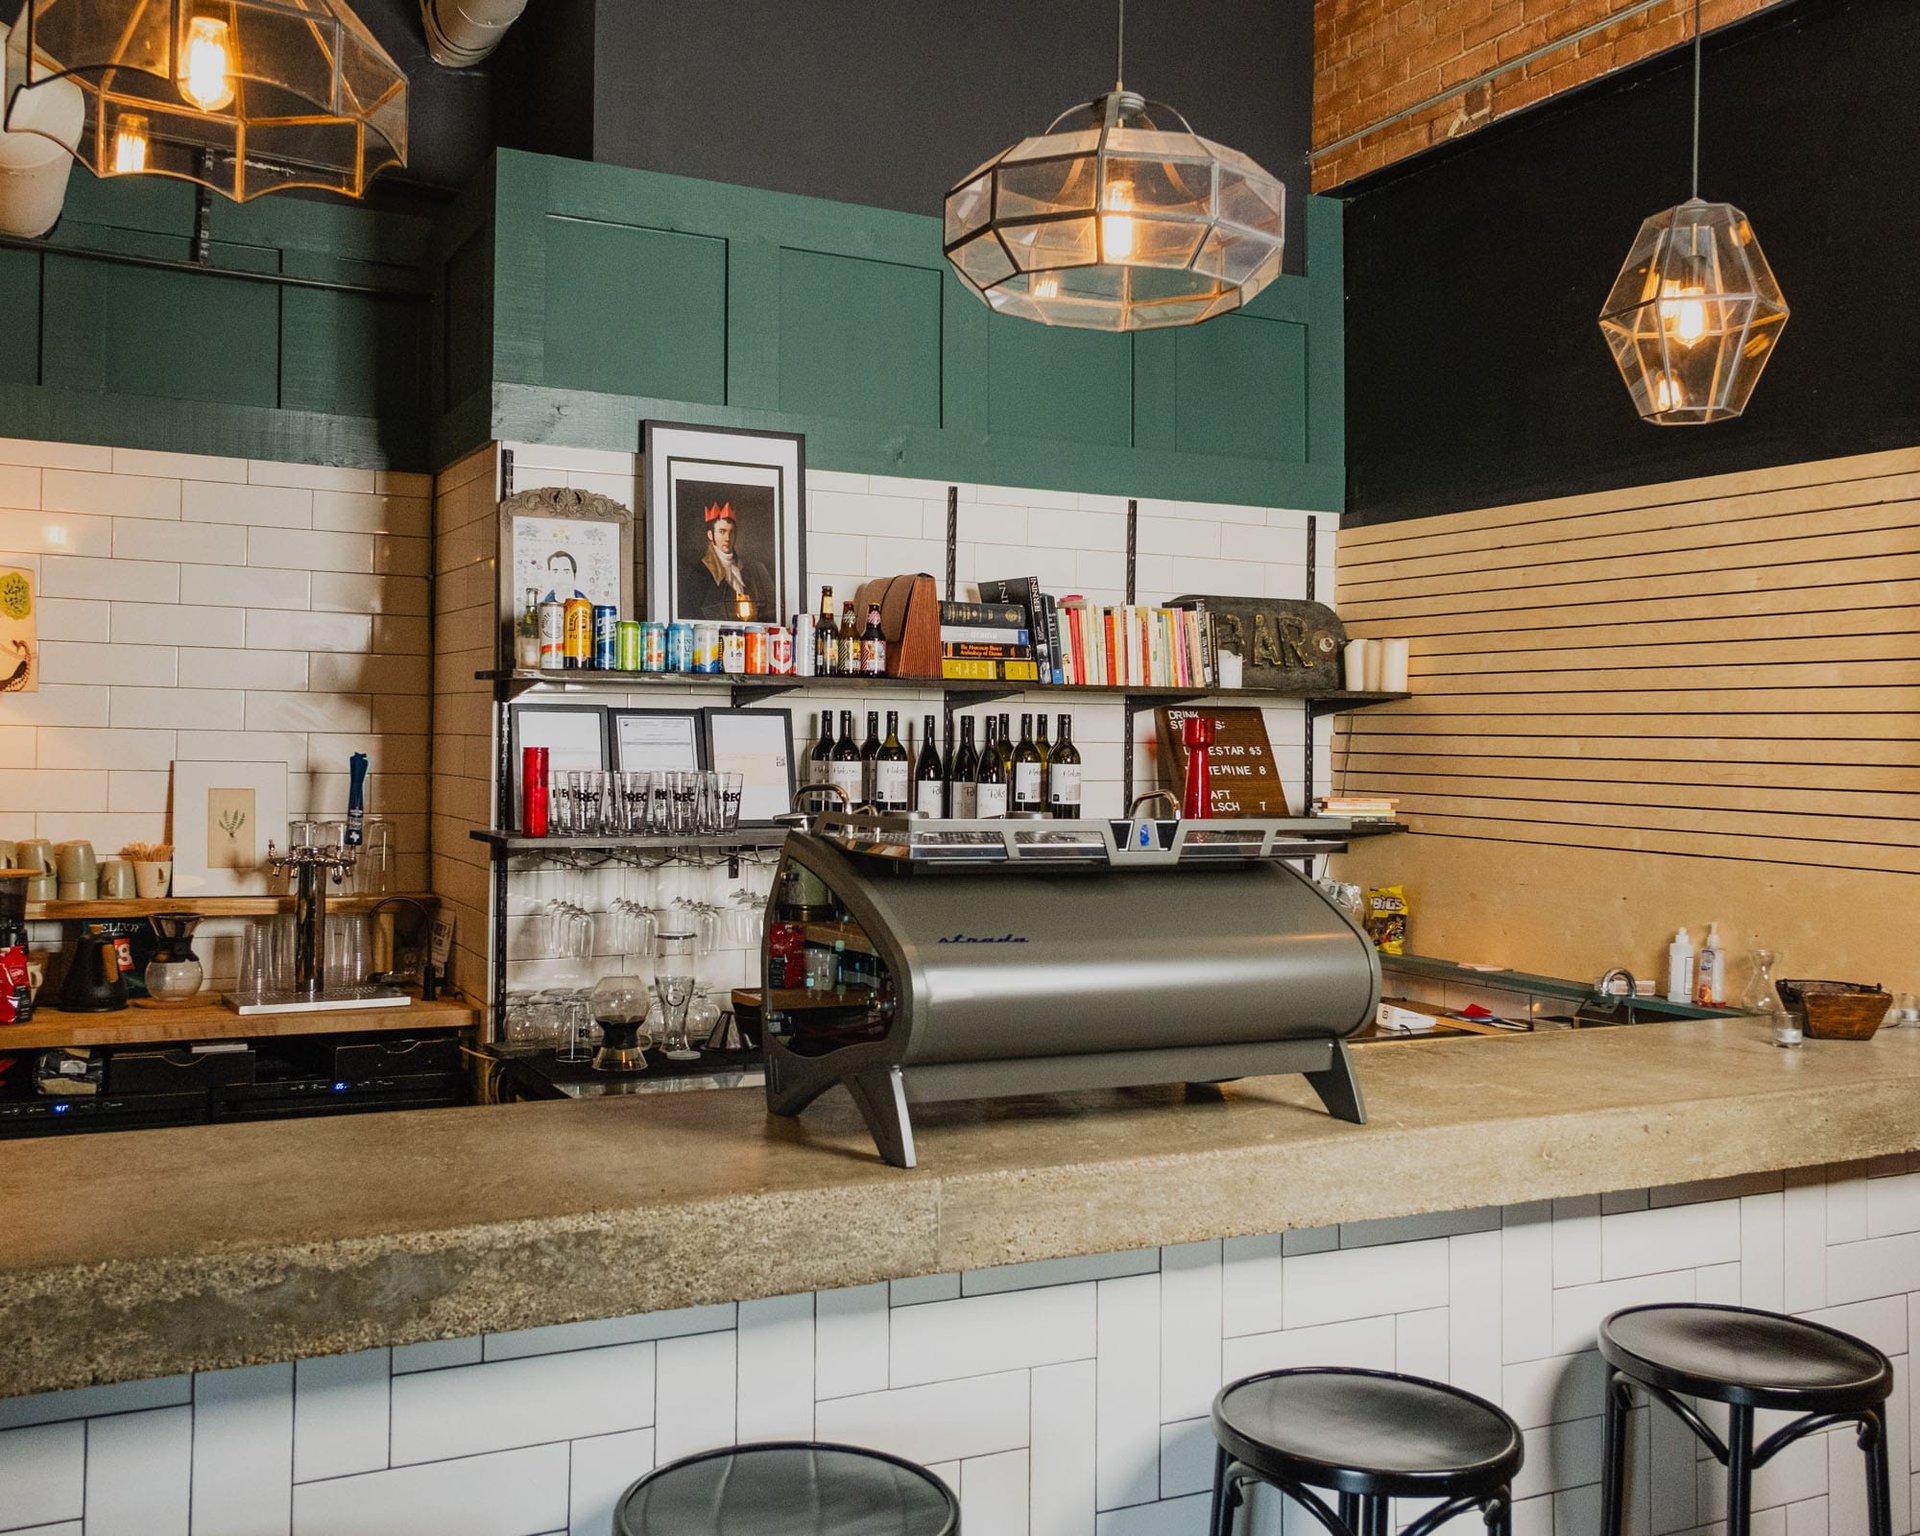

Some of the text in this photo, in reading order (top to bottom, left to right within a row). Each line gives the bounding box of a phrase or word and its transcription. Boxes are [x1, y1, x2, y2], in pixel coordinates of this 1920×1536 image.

[1215, 613, 1314, 667] BAR
[1168, 710, 1199, 720] DRINK
[1259, 766, 1267, 776] 8
[1260, 801, 1266, 811] 7
[938, 934, 1029, 943] strada
